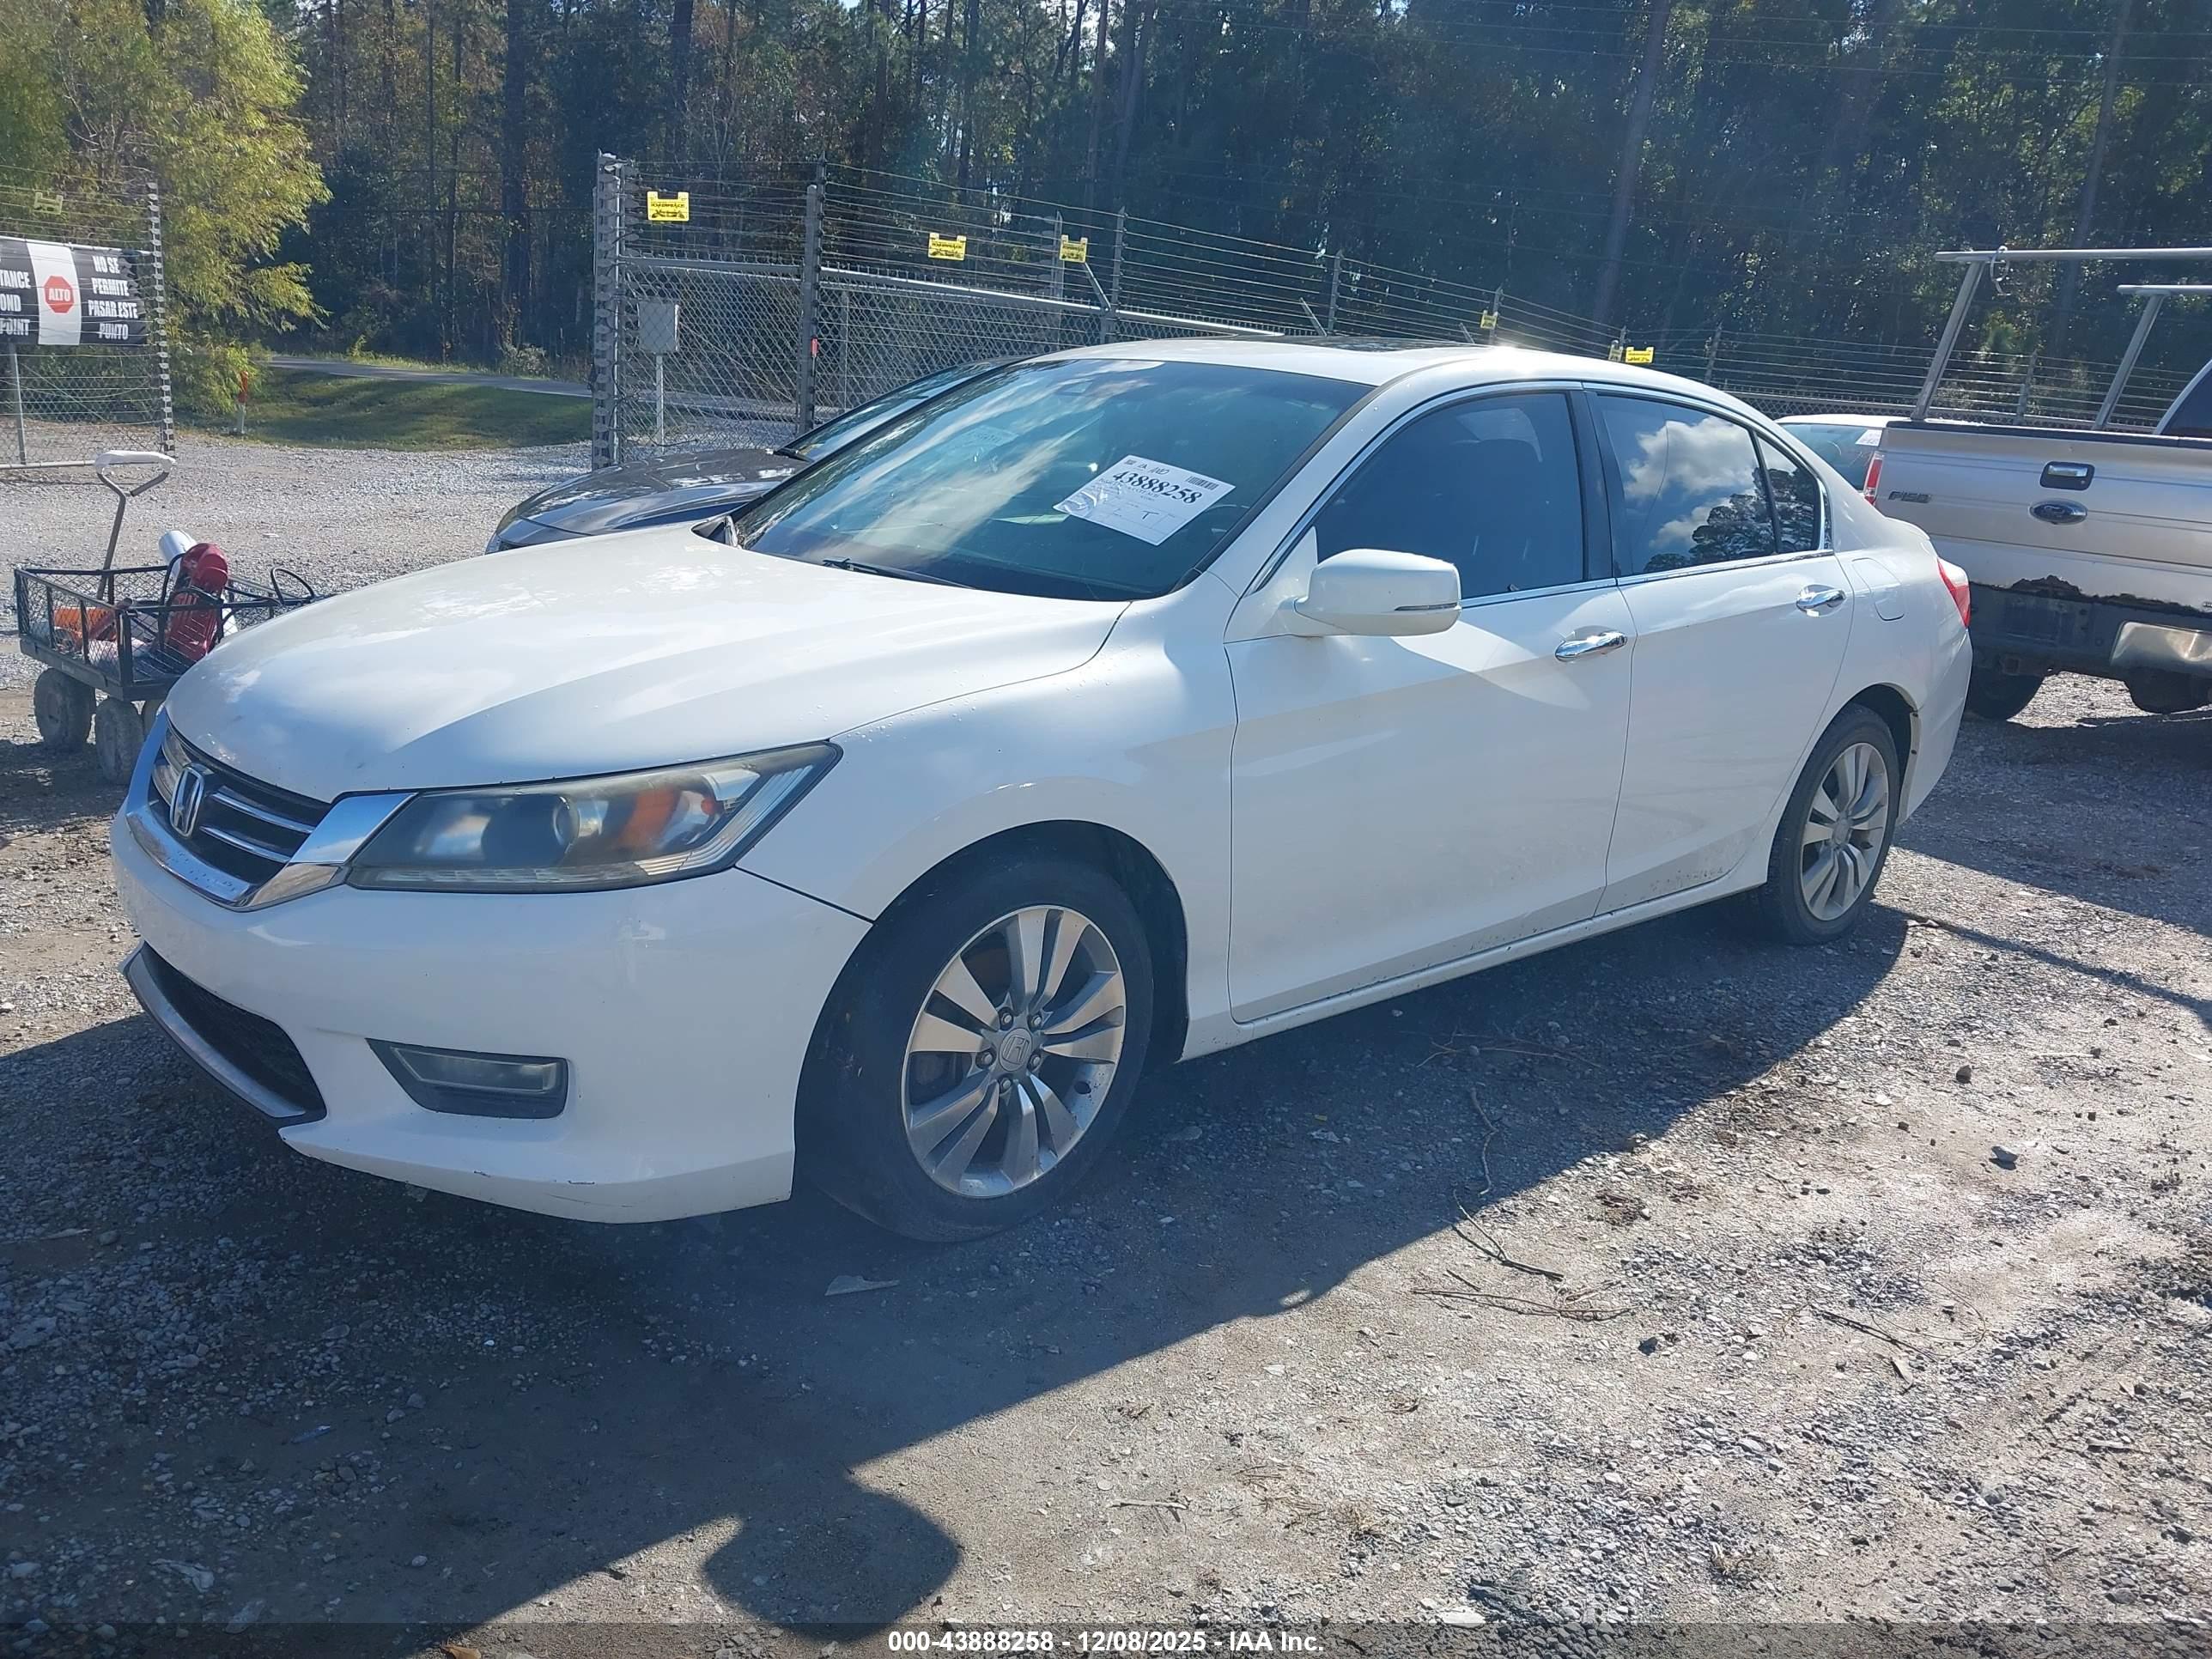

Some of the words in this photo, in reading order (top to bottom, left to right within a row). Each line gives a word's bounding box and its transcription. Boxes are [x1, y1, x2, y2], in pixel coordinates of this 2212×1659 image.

[93, 256, 108, 273] NO
[107, 258, 120, 274] SE
[0, 270, 31, 289] TANCE
[92, 278, 129, 296] PERMITE
[48, 289, 70, 301] ALTO
[88, 301, 117, 317] PASAR
[118, 302, 138, 319] ESTE
[0, 318, 30, 336] POINT
[100, 323, 129, 340] PUNTO
[1112, 471, 1203, 504] 43888258
